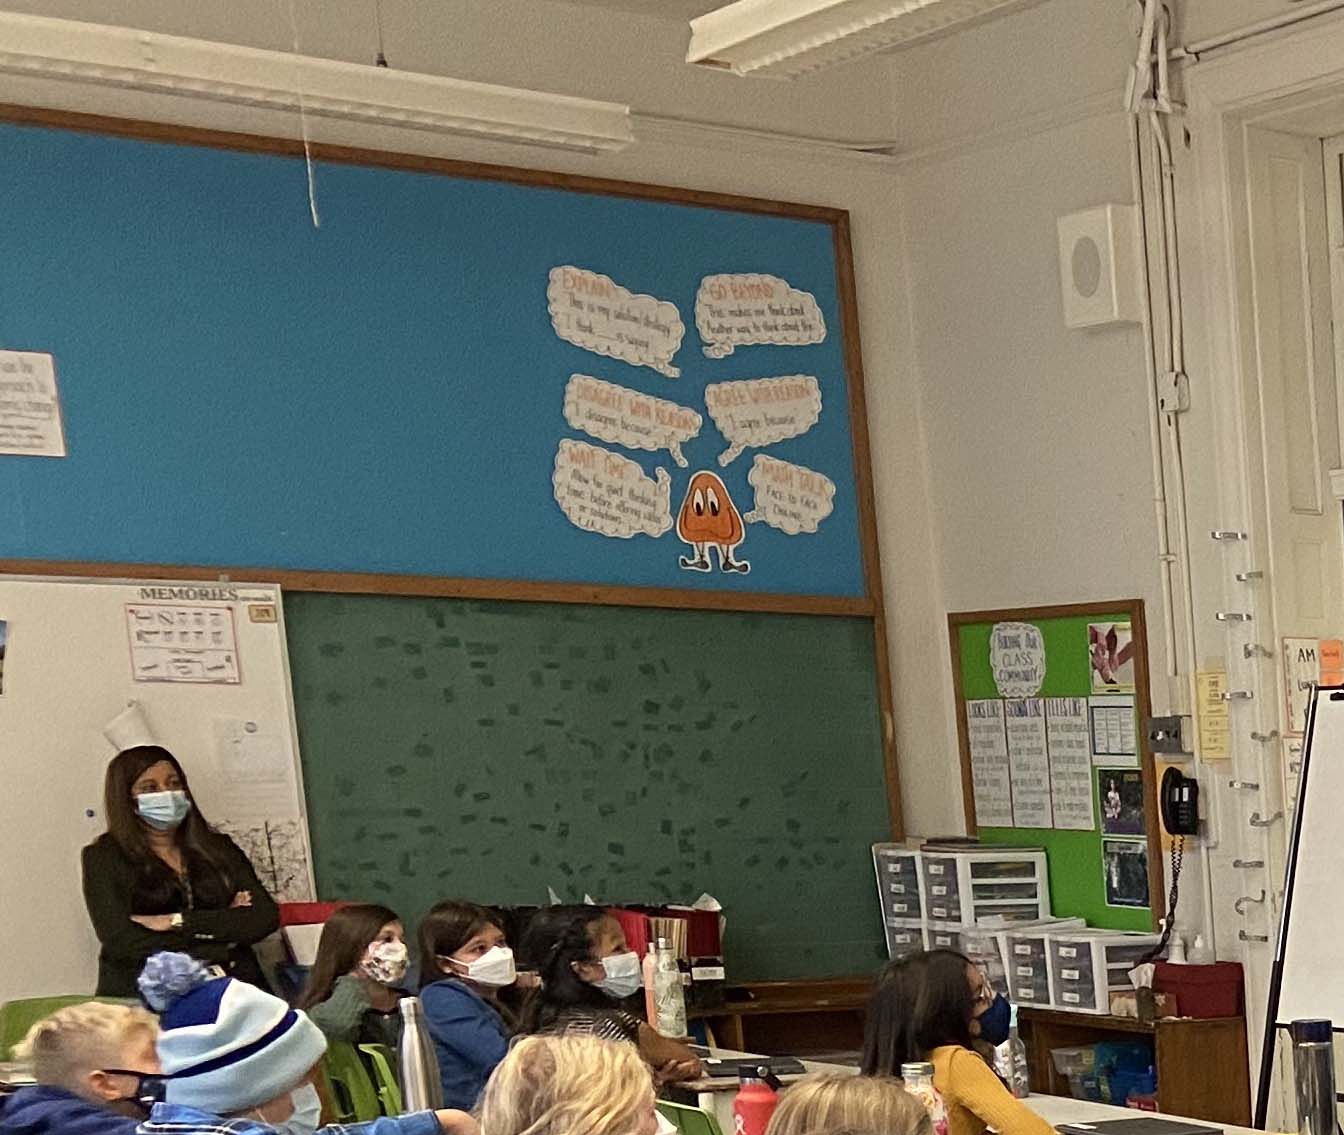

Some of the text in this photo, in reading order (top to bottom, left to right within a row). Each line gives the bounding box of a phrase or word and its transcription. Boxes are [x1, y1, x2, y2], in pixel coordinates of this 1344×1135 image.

[140, 587, 239, 602] MEMORIES
[1002, 651, 1033, 667] CLASS
[1298, 647, 1316, 663] AM
